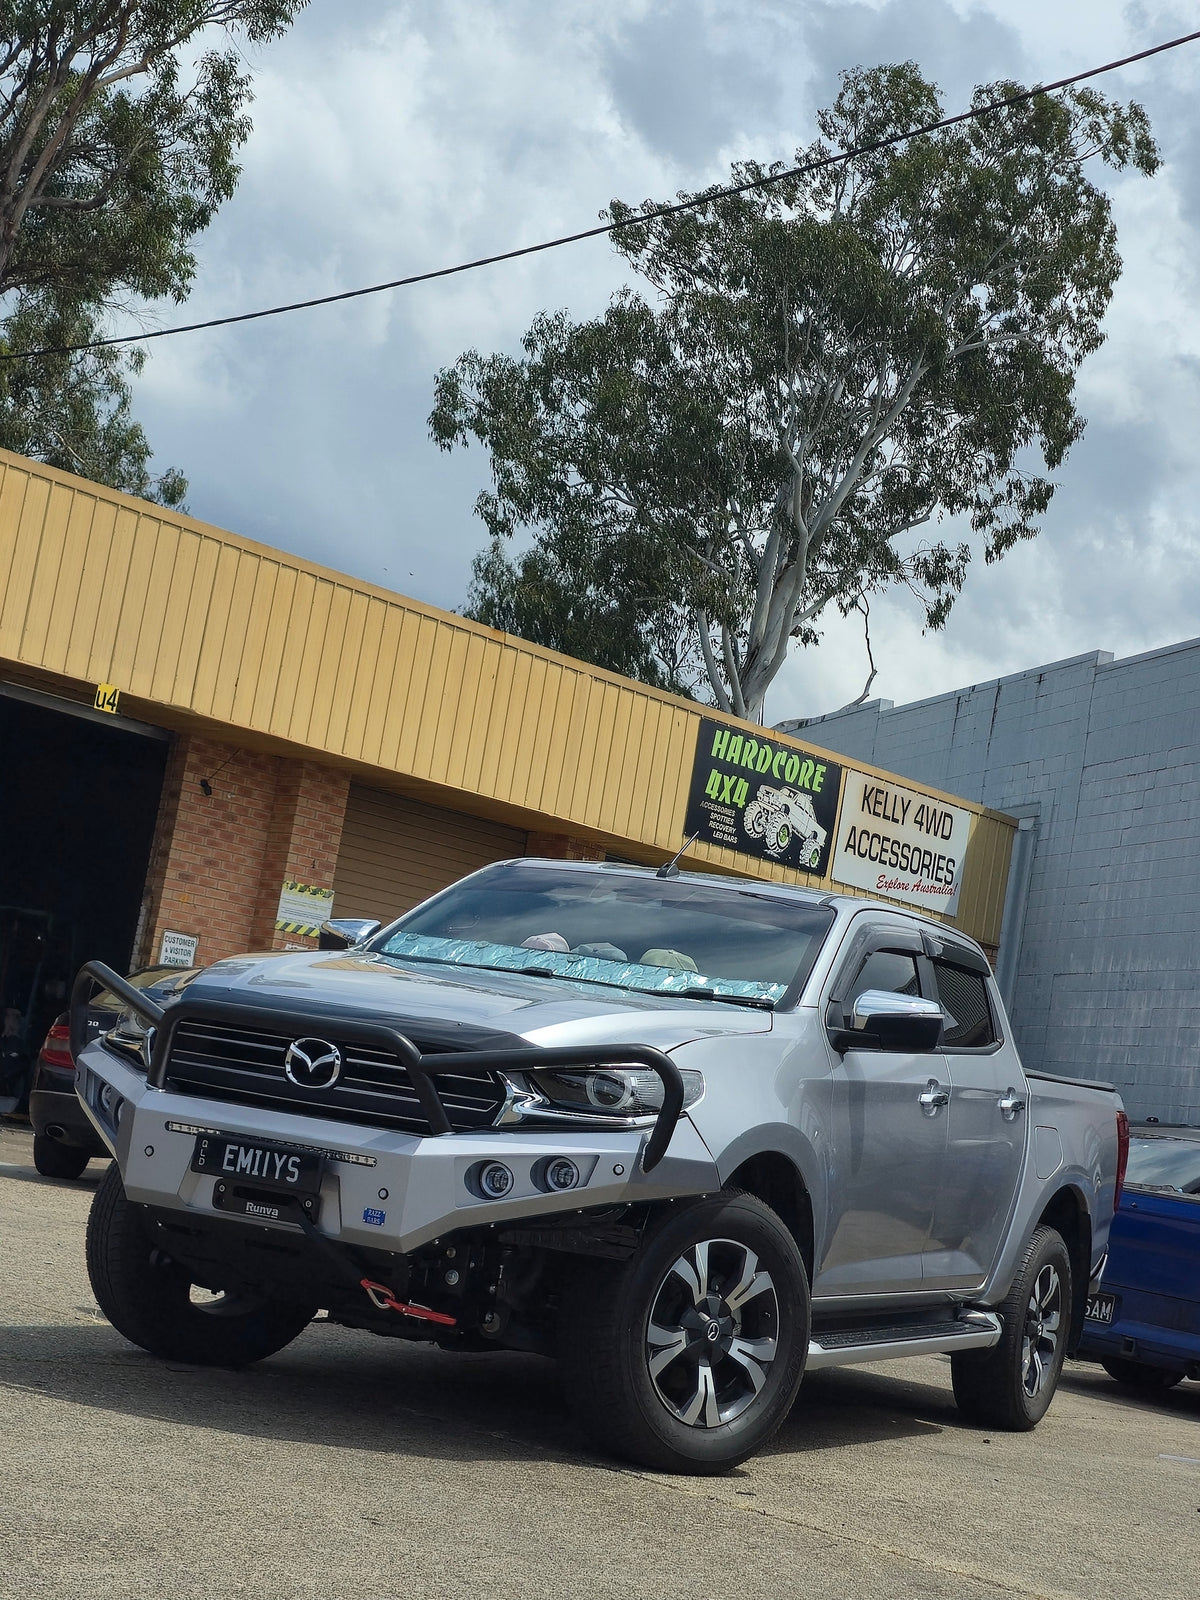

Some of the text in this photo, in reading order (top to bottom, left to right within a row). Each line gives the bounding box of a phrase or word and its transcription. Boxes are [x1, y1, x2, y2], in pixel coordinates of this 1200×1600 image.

[711, 730, 827, 793] HARDCORE
[705, 768, 749, 808] 4X4
[700, 801, 736, 817] ACCESSORIES
[861, 784, 953, 840] KELLY 4WD
[710, 812, 734, 825] SPOTTIES
[709, 820, 736, 834] RECOVERY
[713, 831, 738, 843] LED BARS
[844, 825, 955, 886] ACCESSORIES
[876, 874, 959, 896] Explore Australia!
[165, 935, 196, 947] CUSTOMER
[170, 947, 192, 957] VISITOR
[246, 1201, 279, 1216] Runva
